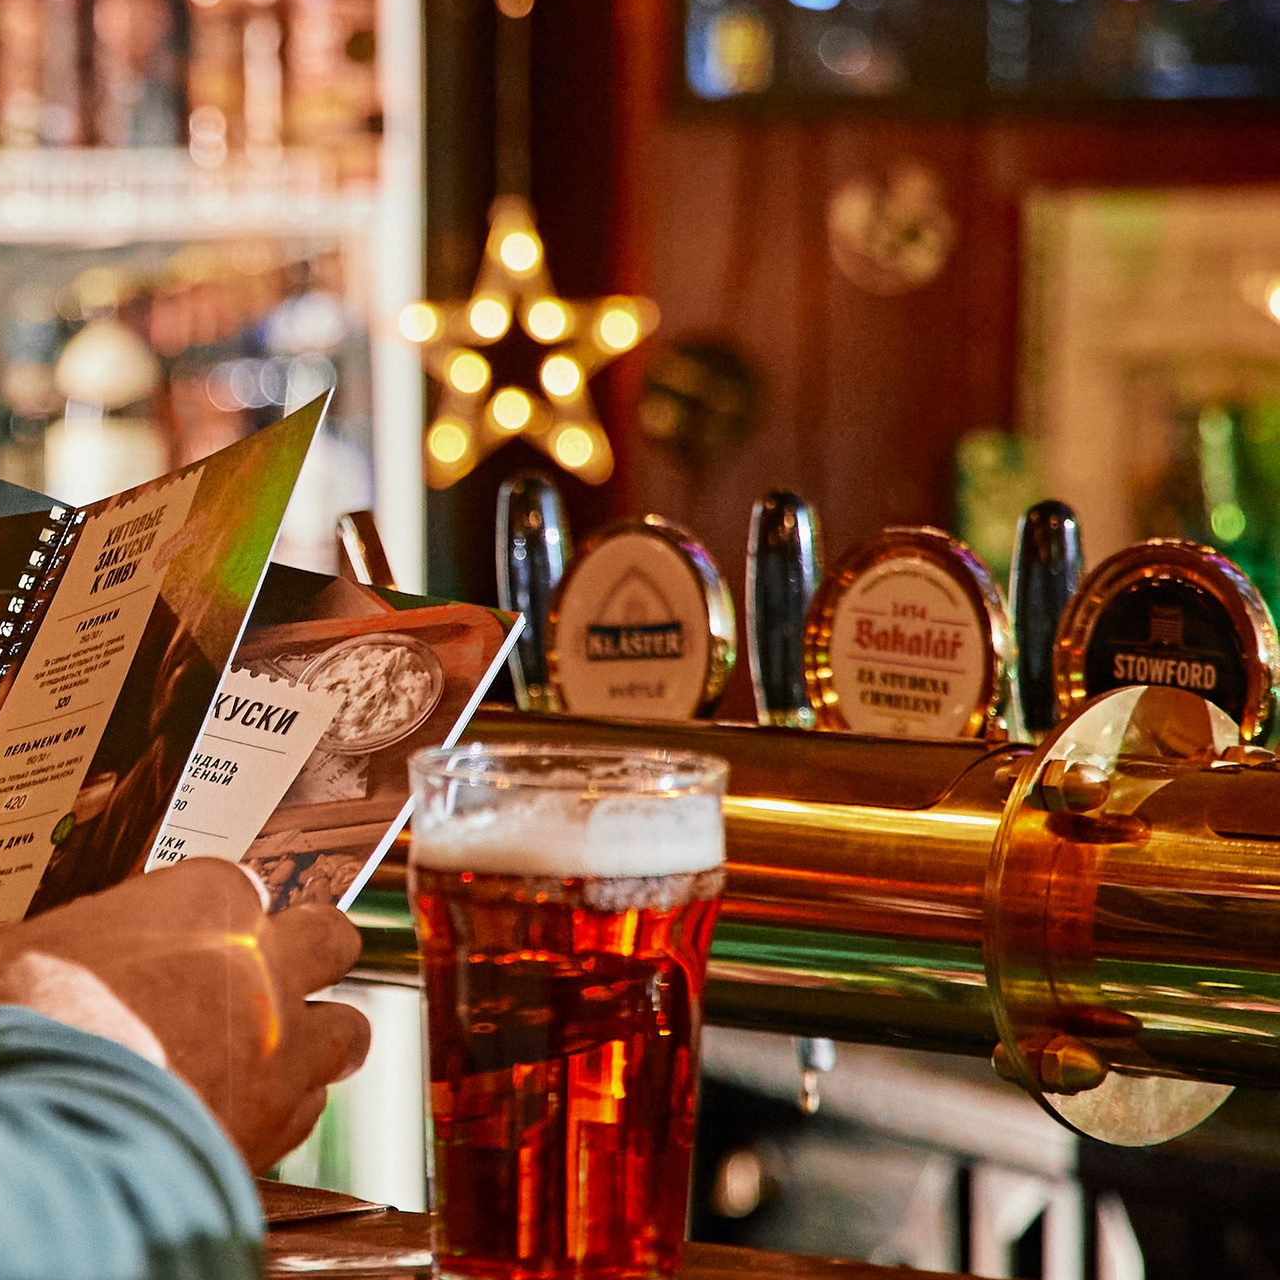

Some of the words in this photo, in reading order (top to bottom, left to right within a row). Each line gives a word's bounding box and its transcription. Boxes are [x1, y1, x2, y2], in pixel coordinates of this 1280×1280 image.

[103, 504, 168, 549] ХИТОВЫЕ
[94, 529, 159, 572] ЗАКУСКИ
[90, 572, 105, 595] К
[102, 557, 142, 590] ПИВУ
[75, 607, 121, 634] ГАРЛИКИ
[1113, 654, 1218, 690] STOWFORD
[3, 733, 62, 757] ПЕЛЬМЕНИ
[63, 724, 86, 742] ФРИ
[3, 794, 28, 811] 420
[4, 832, 35, 851] ДИЧЬ
